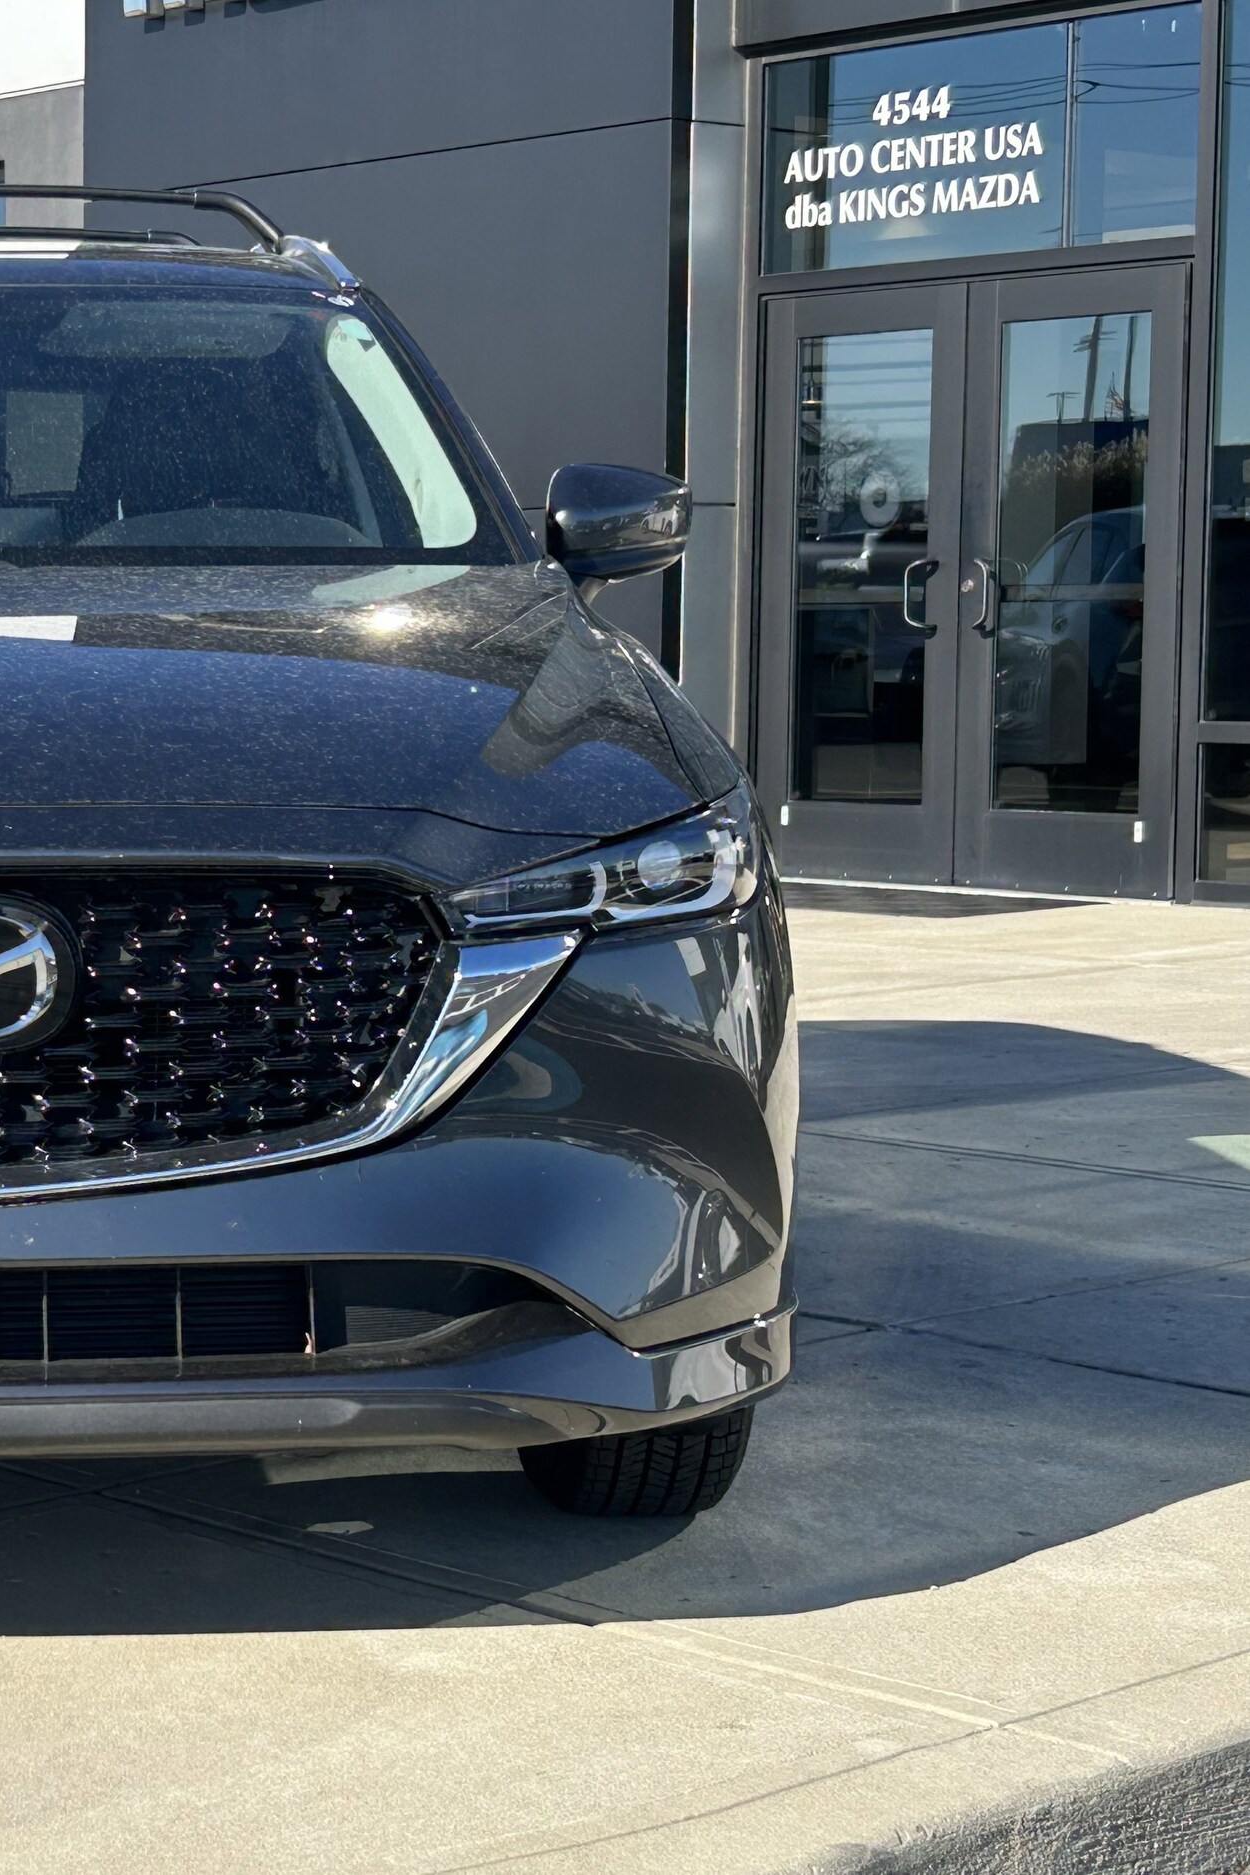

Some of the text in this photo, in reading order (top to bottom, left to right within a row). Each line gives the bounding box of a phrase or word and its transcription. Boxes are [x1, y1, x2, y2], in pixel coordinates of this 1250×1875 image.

[872, 87, 952, 126] 4544
[784, 122, 1043, 183] AUTO CENTER USA
[785, 171, 1040, 229] dba KINGS MAZDA
